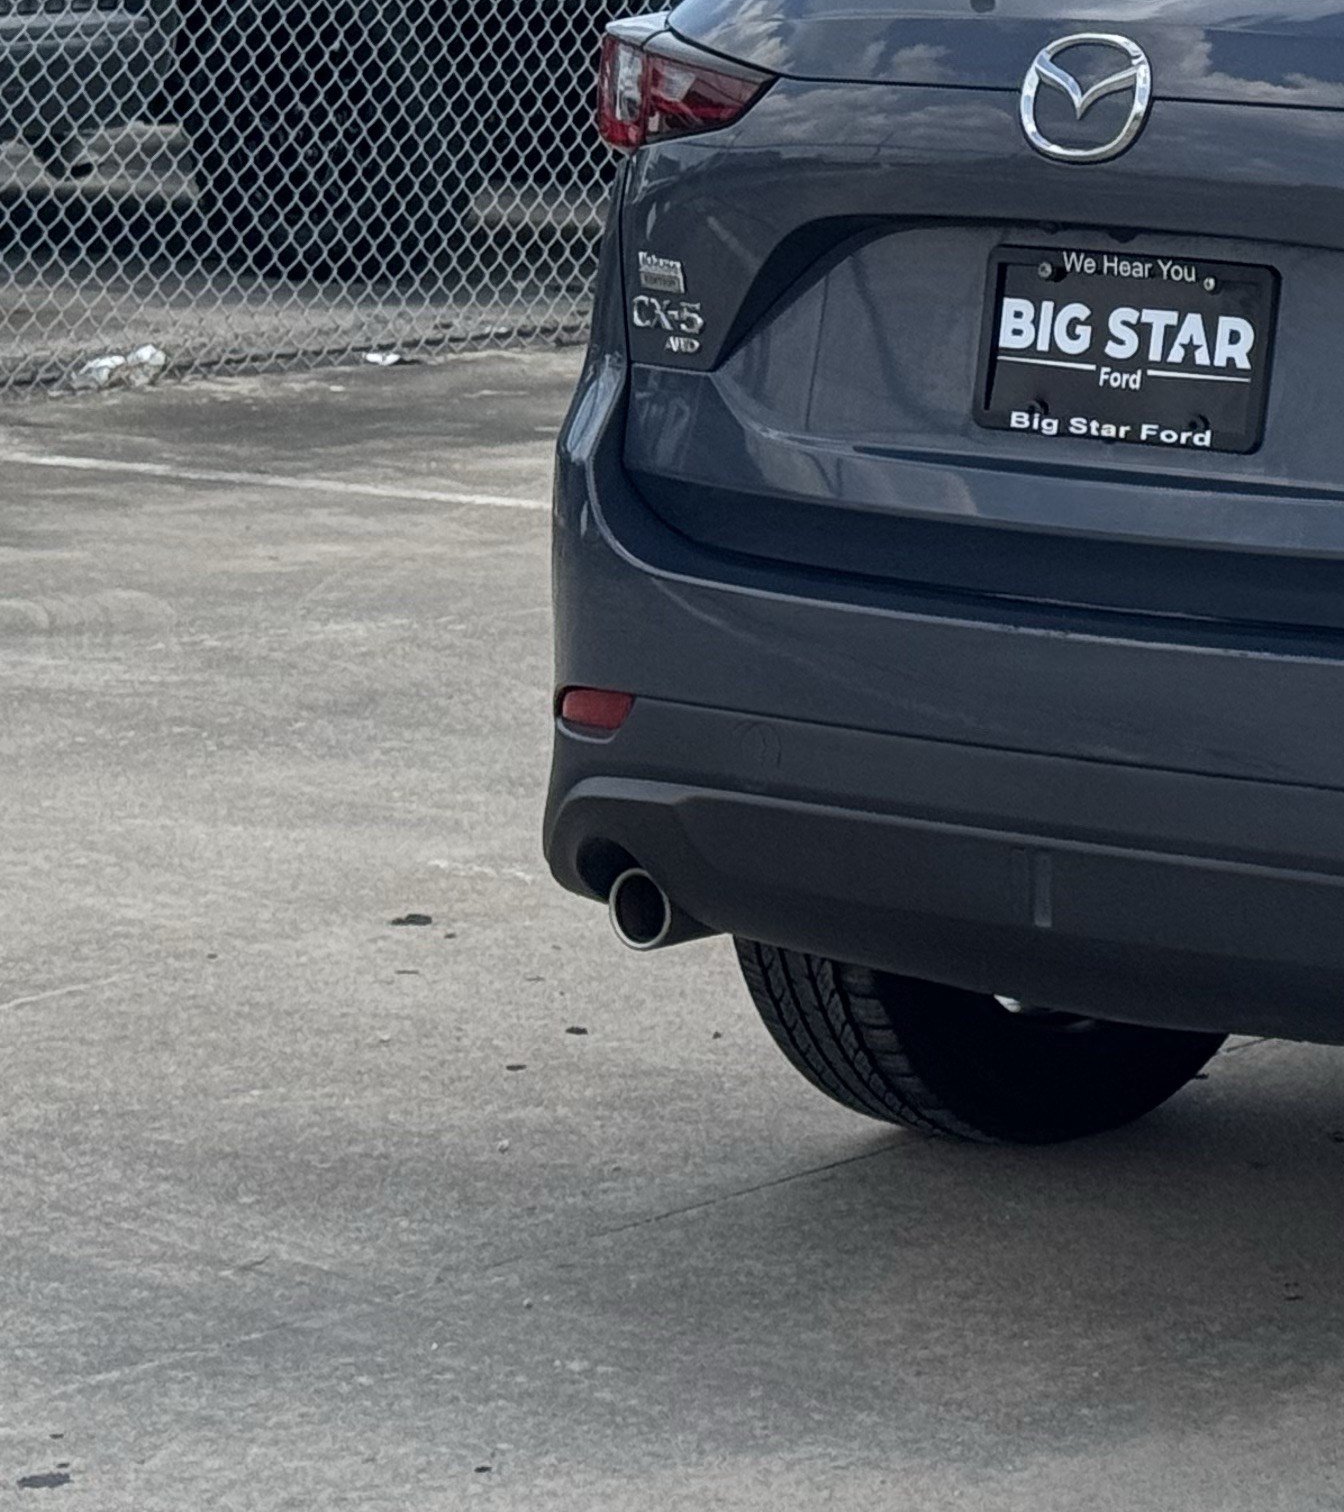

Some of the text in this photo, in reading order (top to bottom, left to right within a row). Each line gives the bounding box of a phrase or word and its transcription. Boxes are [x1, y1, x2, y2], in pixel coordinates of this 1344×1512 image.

[1062, 251, 1197, 283] We Hear You
[632, 294, 704, 334] CX-5
[998, 296, 1255, 370] BIG STAR
[1099, 365, 1143, 391] Ford
[1009, 410, 1213, 447] Big Star Ford
